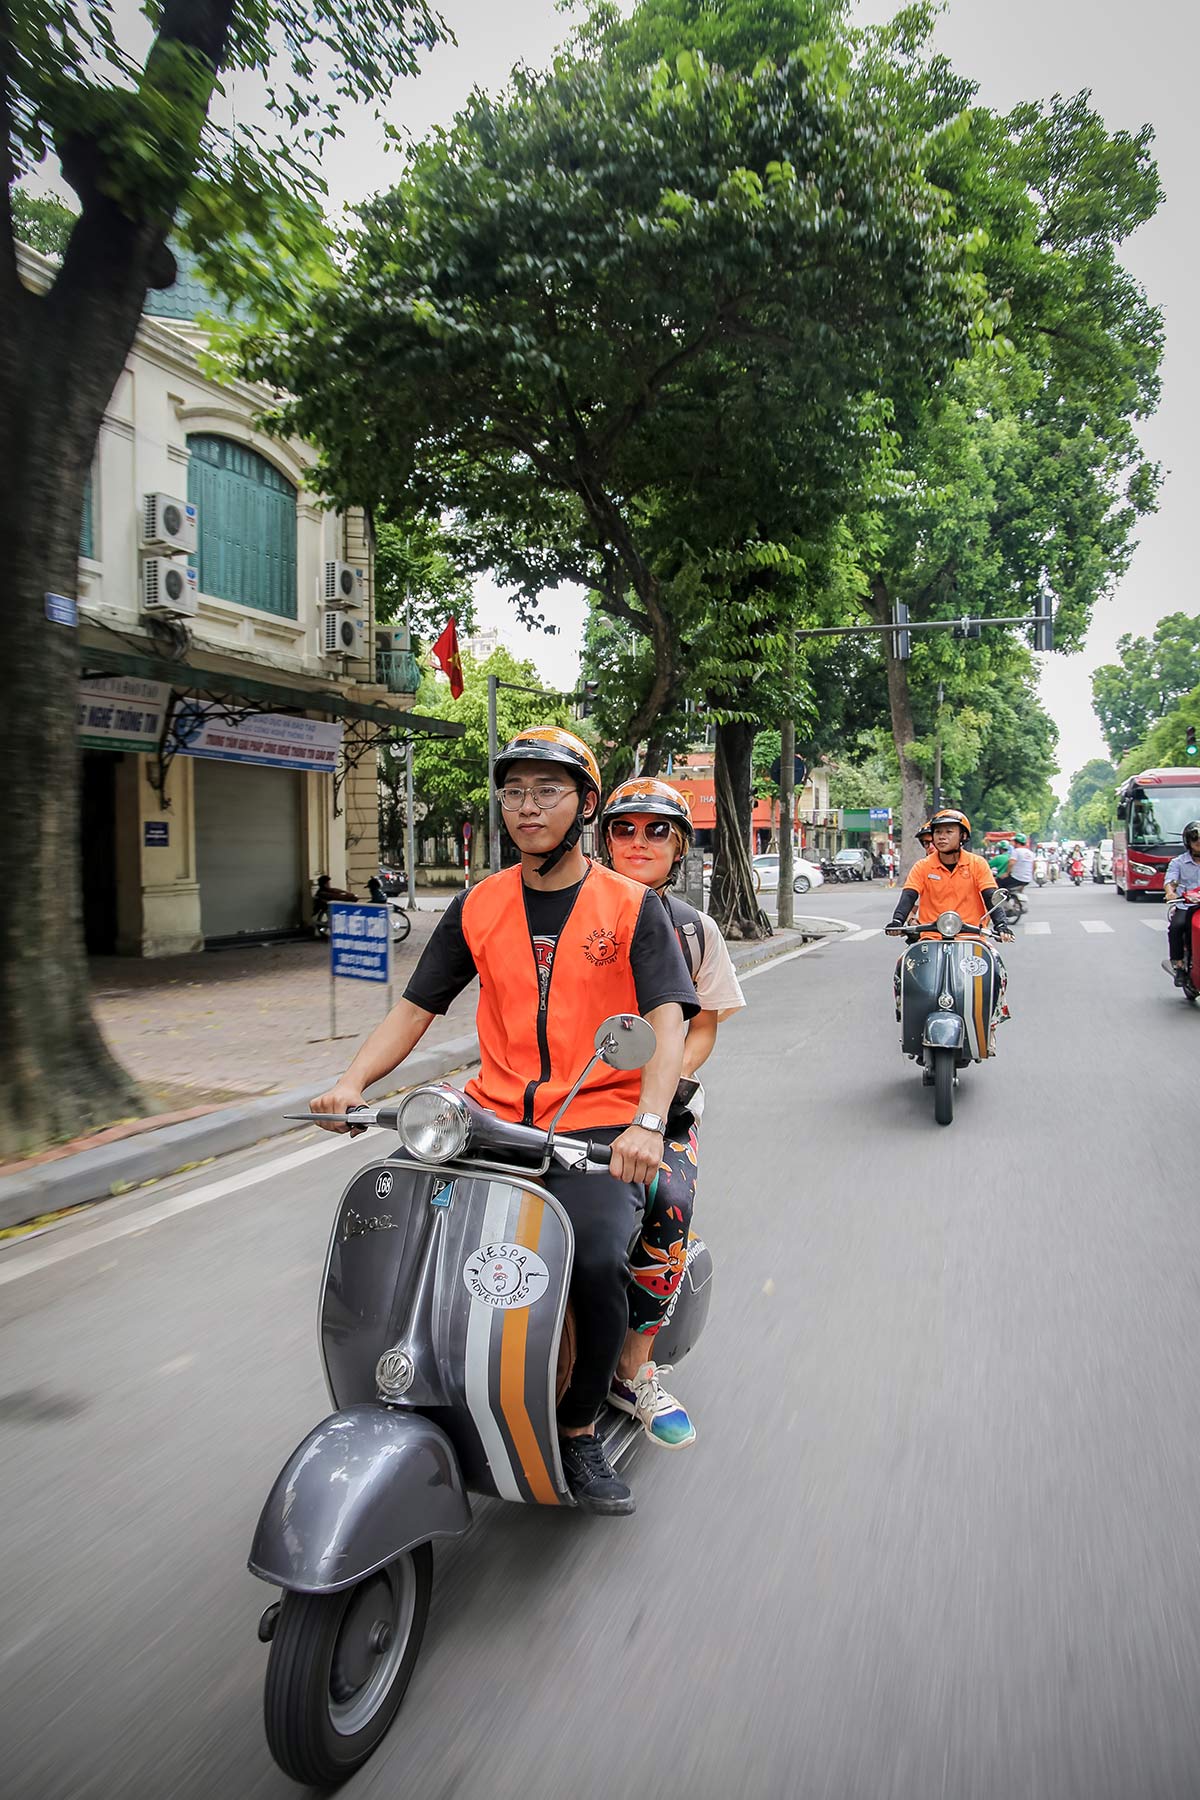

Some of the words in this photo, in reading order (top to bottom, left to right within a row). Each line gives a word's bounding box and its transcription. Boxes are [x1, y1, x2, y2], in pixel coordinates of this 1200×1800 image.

[586, 928, 617, 942] VESPA
[377, 1177, 392, 1194] 168
[476, 1245, 527, 1268] VESPA
[470, 1278, 530, 1306] ADVENTURES
